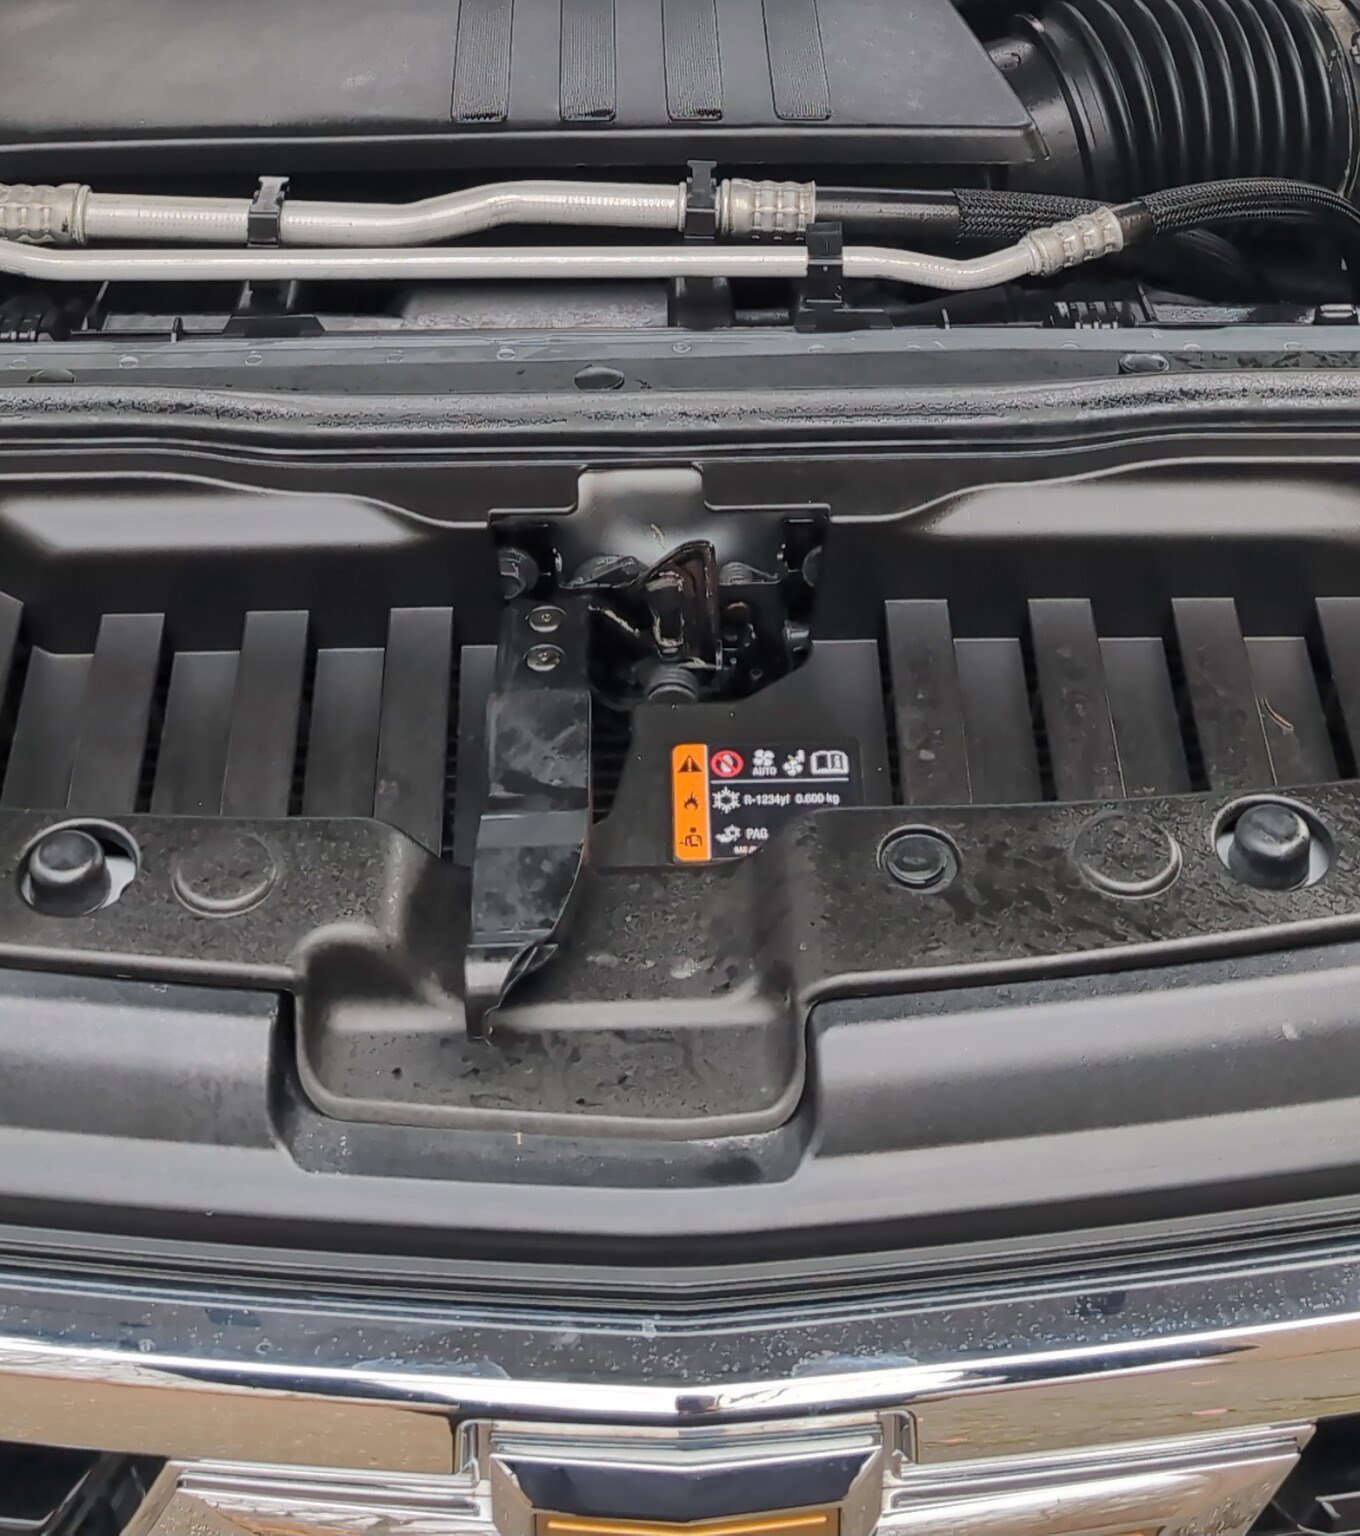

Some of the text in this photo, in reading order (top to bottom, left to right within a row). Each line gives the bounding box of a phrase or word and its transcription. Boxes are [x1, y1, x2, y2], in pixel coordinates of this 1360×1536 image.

[751, 766, 777, 776] AUTO
[743, 793, 790, 807] R-1234yf
[826, 792, 840, 806] kg
[745, 827, 769, 840] PAG
